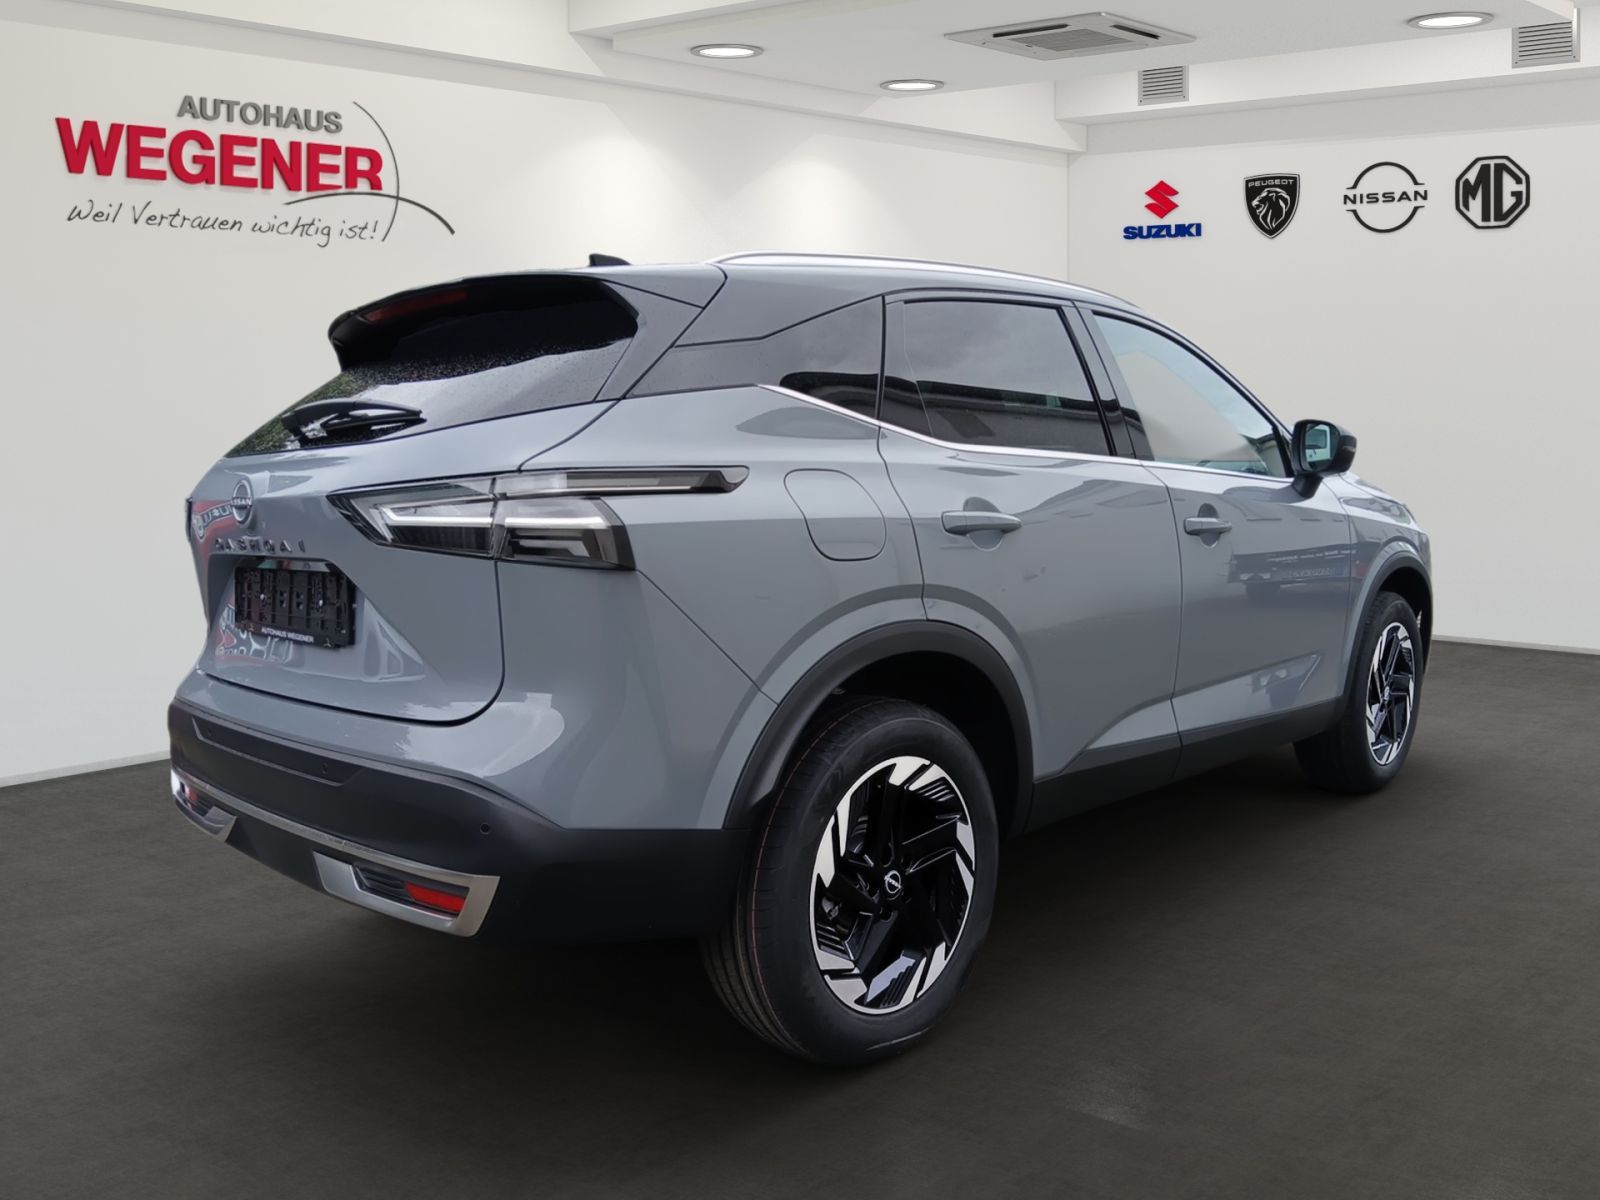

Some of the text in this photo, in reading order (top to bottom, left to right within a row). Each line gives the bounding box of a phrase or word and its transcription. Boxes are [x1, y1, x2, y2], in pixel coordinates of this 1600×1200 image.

[177, 95, 343, 134] AUTOHAUS
[55, 117, 383, 192] WEGENER
[1248, 179, 1295, 188] PEUGEOT
[1343, 189, 1429, 205] NISSAN
[1461, 163, 1523, 223] MG
[67, 199, 379, 248] Weil Vertrauen wichtig ist!
[1123, 222, 1202, 240] SUZUKI
